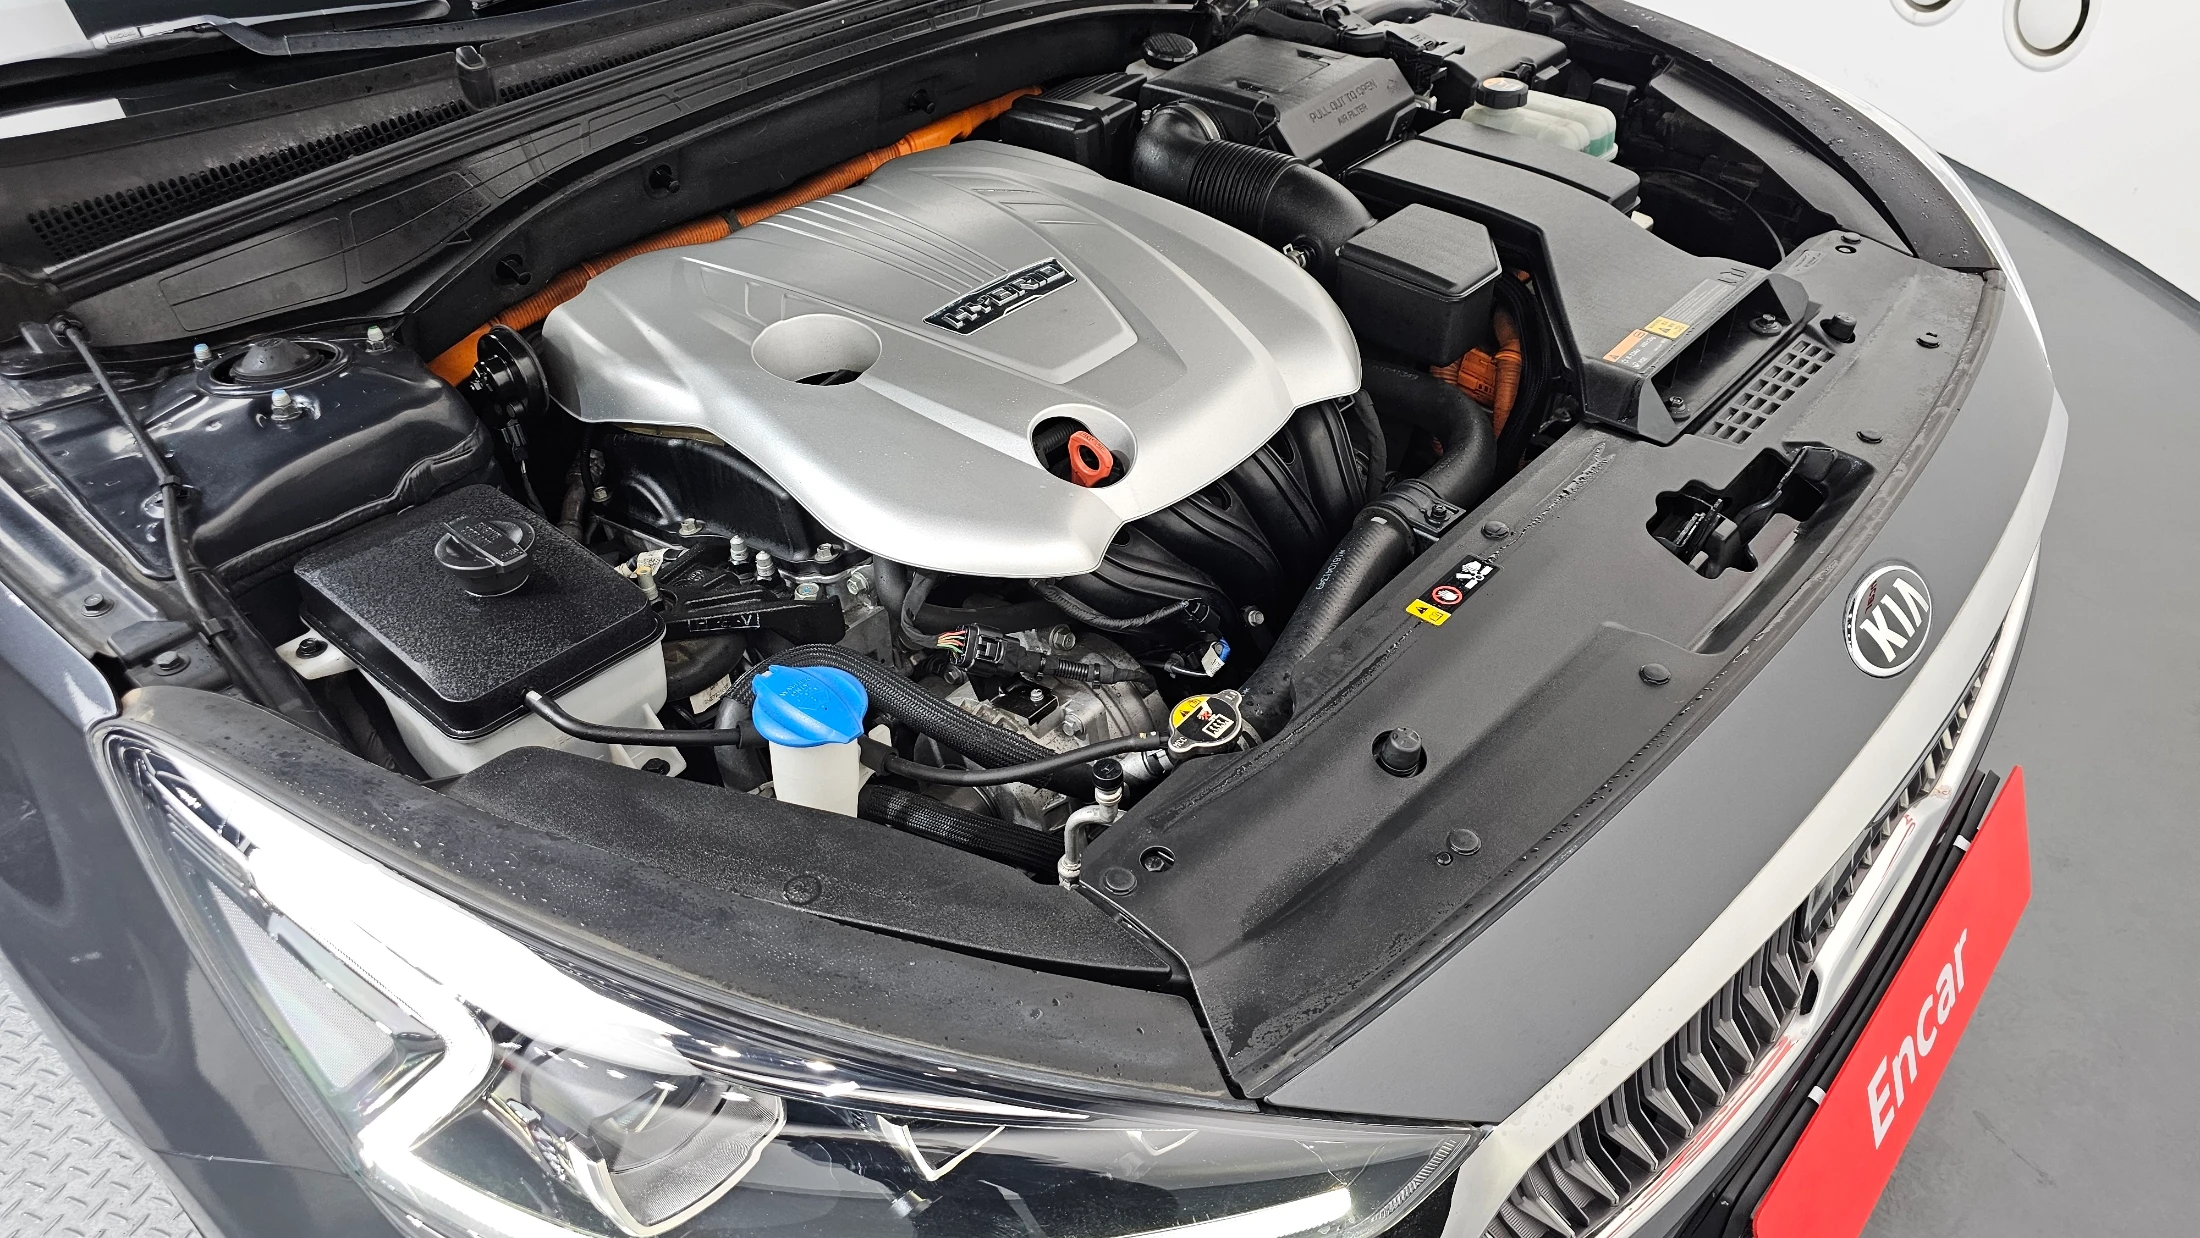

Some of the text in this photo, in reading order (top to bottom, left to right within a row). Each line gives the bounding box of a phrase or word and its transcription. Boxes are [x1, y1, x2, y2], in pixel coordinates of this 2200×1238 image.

[1309, 79, 1378, 123] PULL OUT TO OPEN
[1337, 103, 1369, 126] AIR FILTER
[941, 263, 1067, 330] HYBRID
[1859, 577, 1930, 663] KIA
[1172, 736, 1188, 749] HCC
[1867, 927, 1968, 1151] Encar
